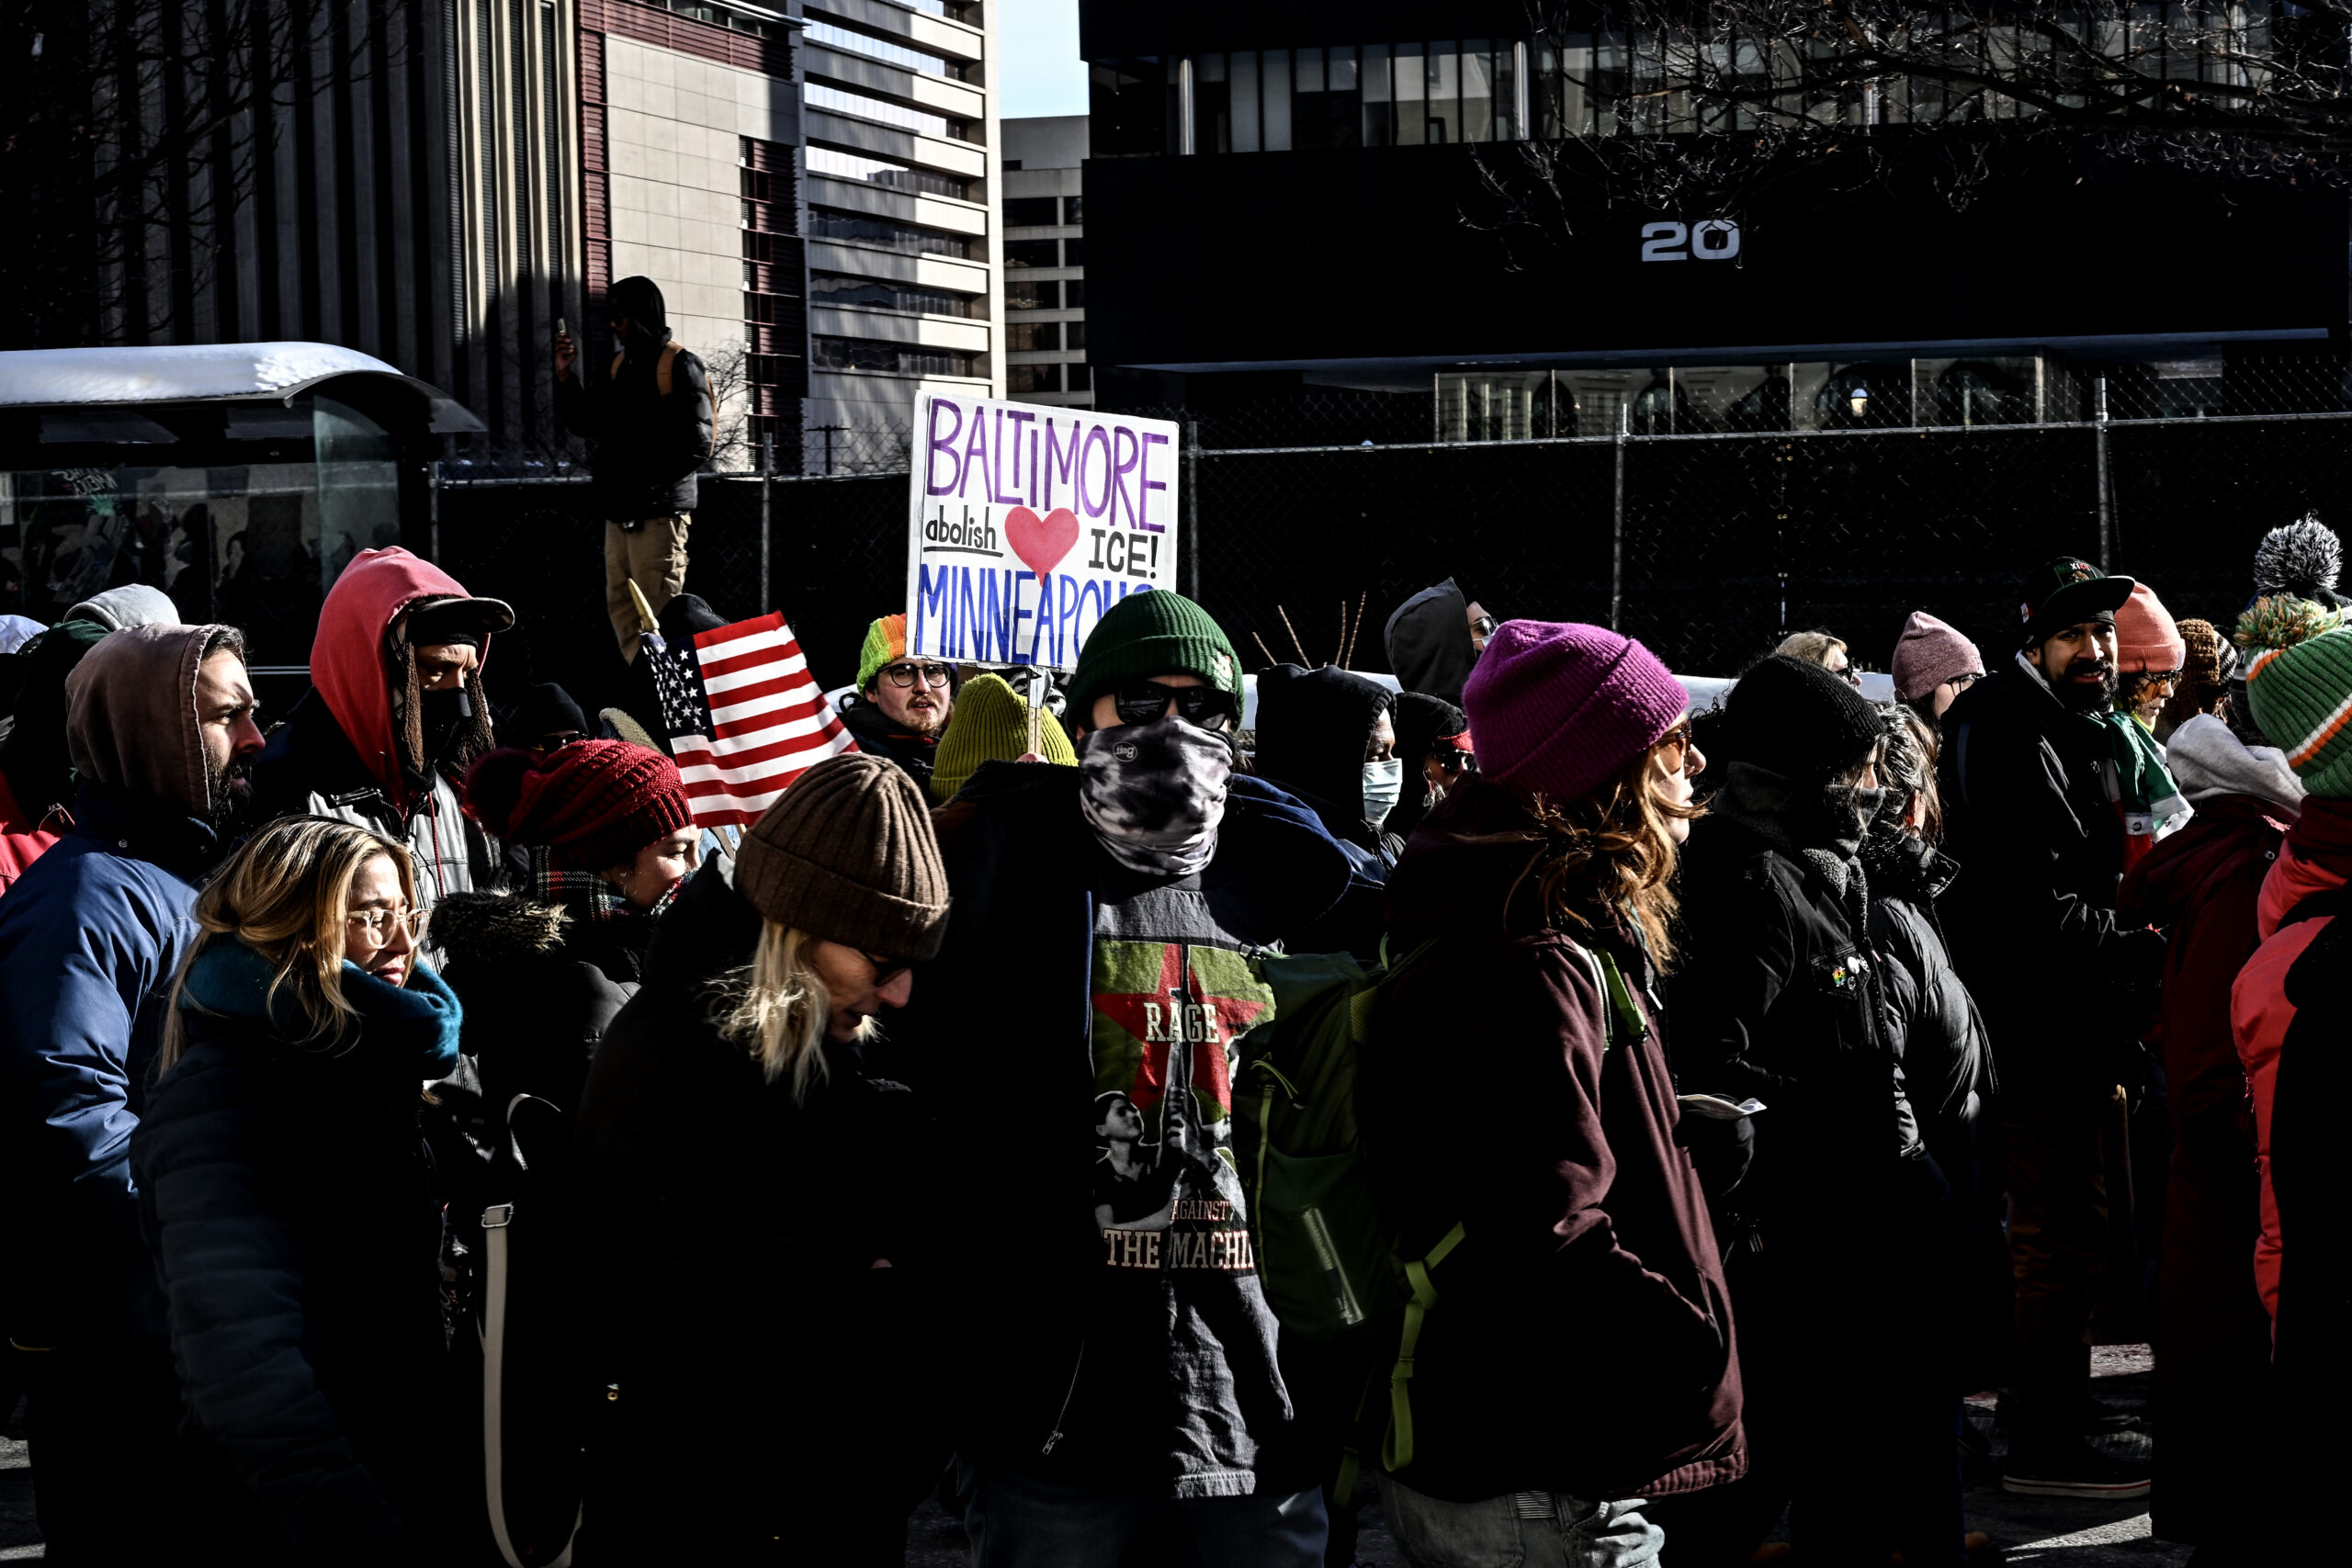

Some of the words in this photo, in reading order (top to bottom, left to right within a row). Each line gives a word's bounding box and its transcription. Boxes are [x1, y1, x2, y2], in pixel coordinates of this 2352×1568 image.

[1641, 220, 1741, 262] 20
[926, 398, 1169, 534] BALTIMORE
[925, 505, 997, 550] abolish
[1088, 528, 1159, 580] ICE!
[916, 563, 1154, 668] MINNEAPO
[1144, 1001, 1220, 1043] RAGE
[1170, 1199, 1230, 1223] AGAINST
[1103, 1228, 1161, 1269] THE
